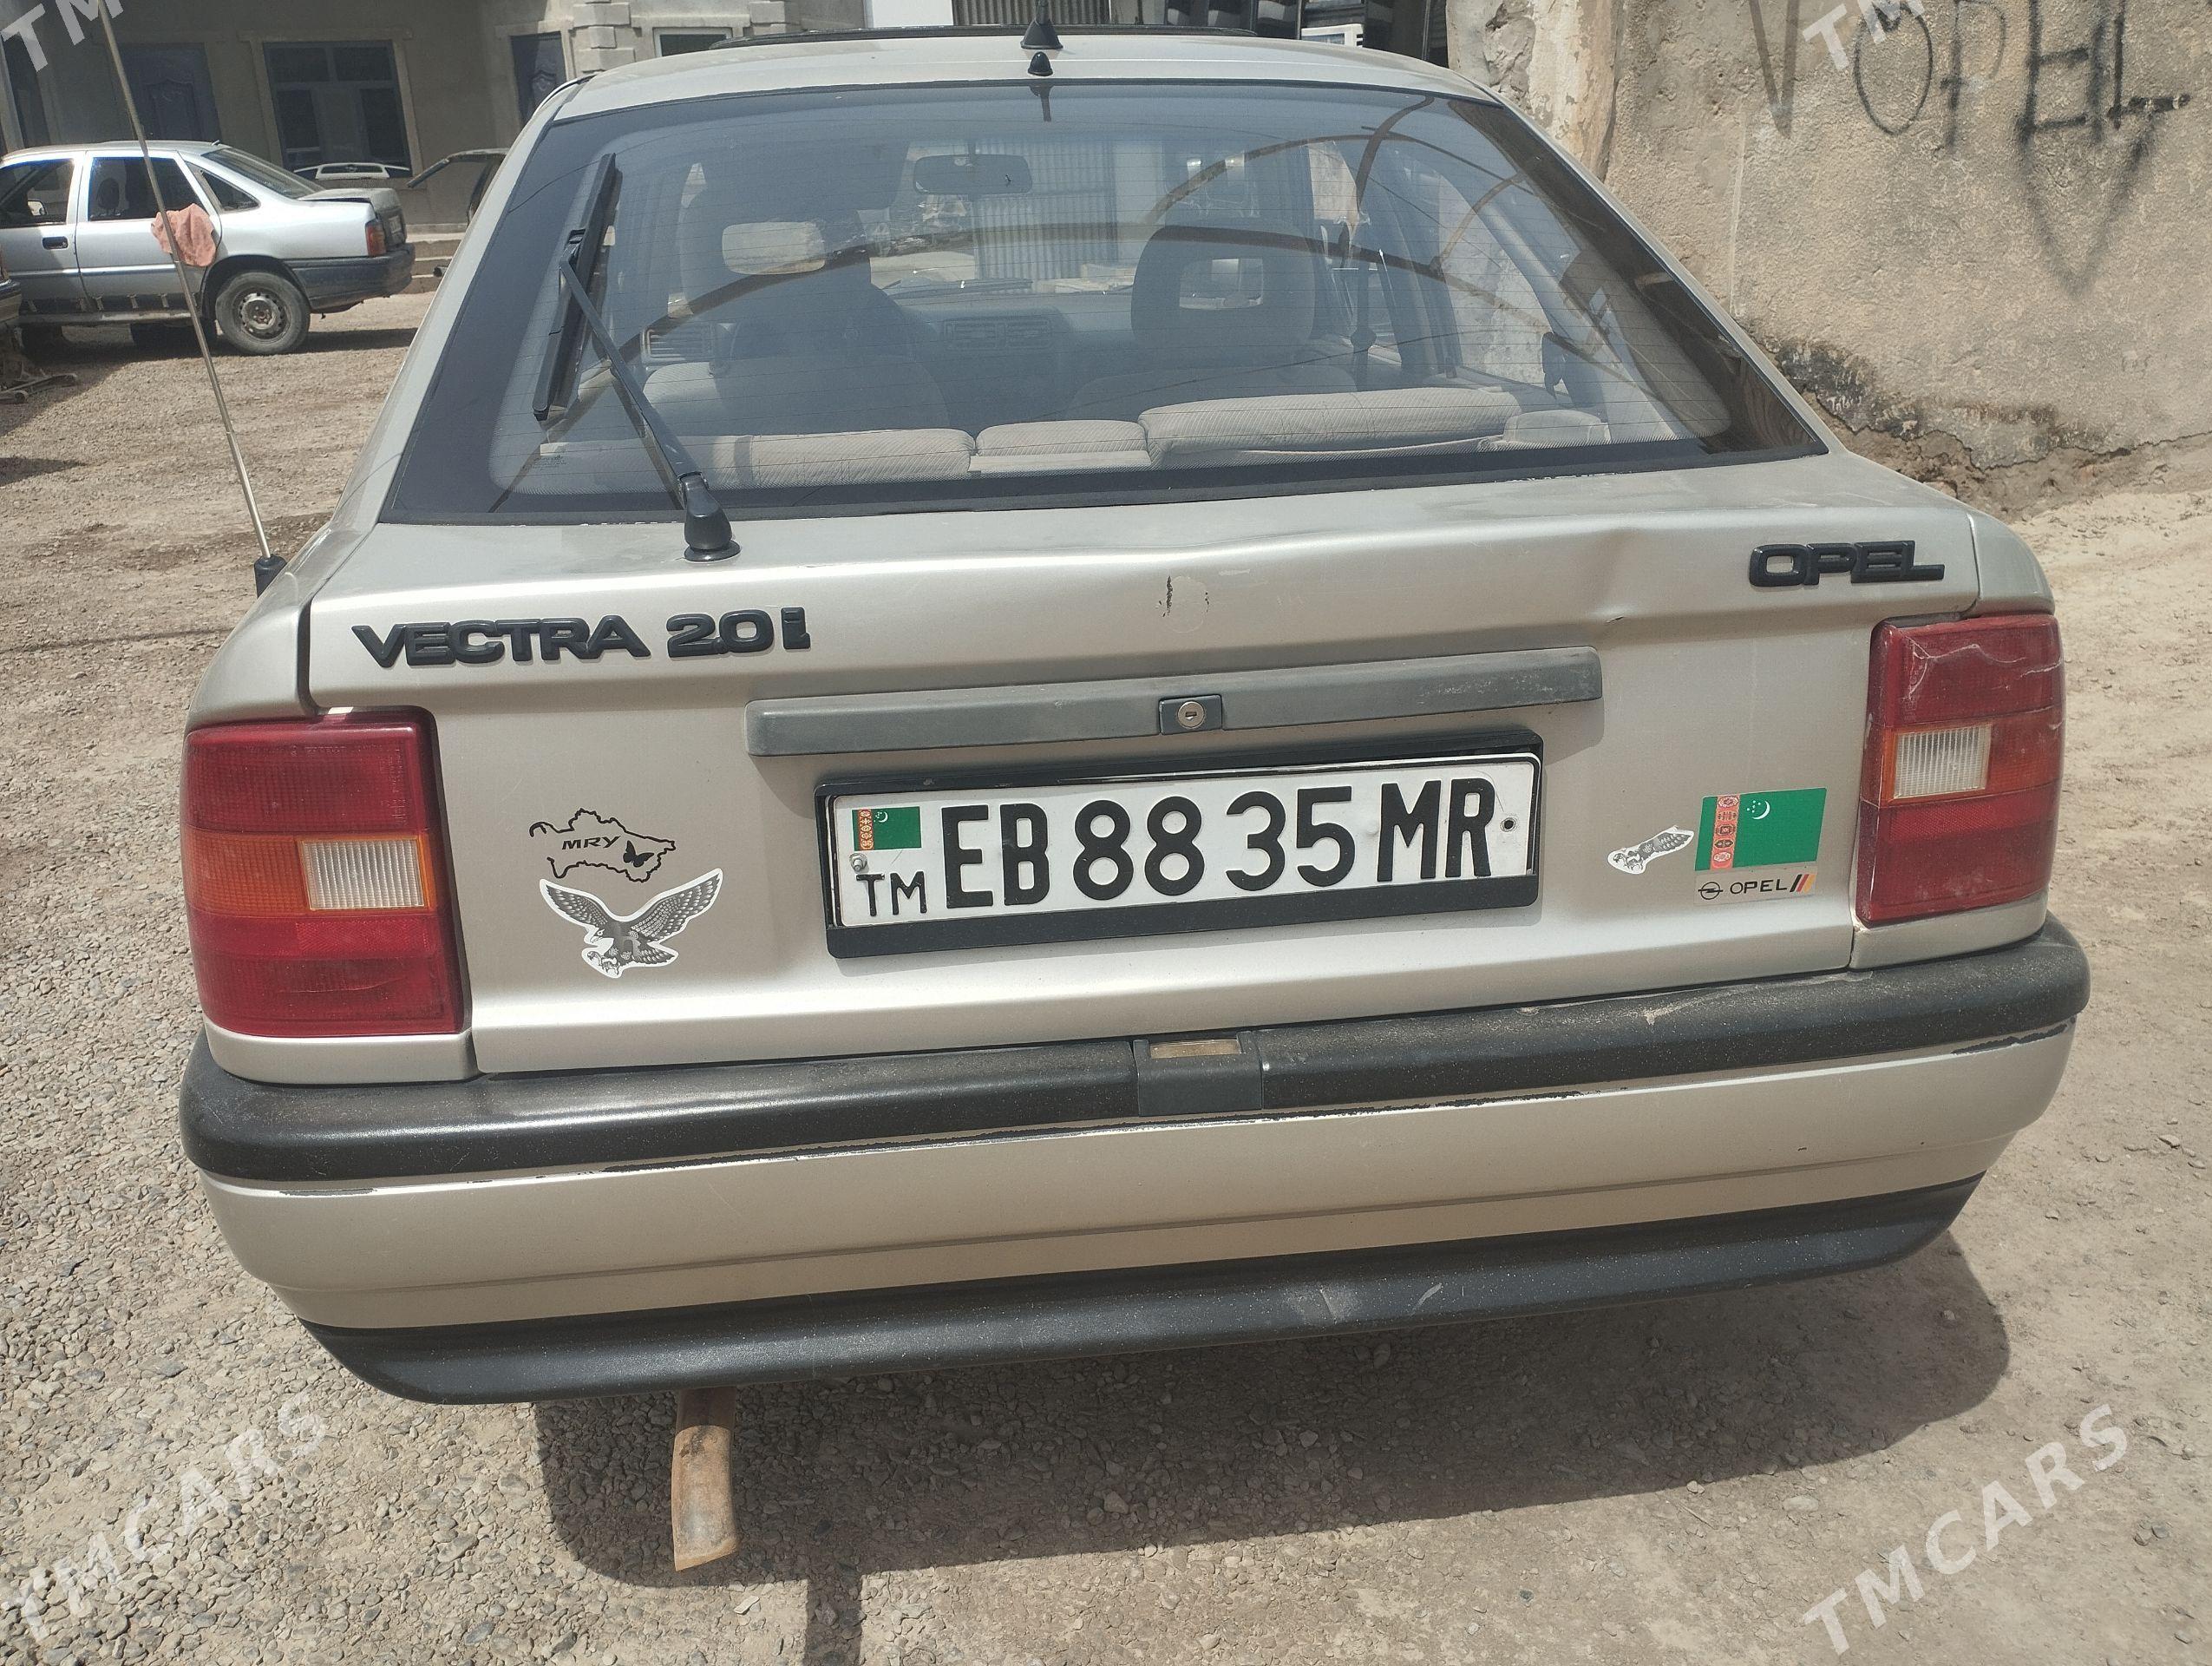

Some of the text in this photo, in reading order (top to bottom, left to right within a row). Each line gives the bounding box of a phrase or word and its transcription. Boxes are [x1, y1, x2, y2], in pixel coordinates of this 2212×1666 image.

[1748, 541, 1946, 587] OPEL
[350, 614, 652, 669] VECTRA
[561, 835, 622, 850] MRY
[855, 870, 928, 916] TM
[1729, 878, 1789, 895] OPEL
